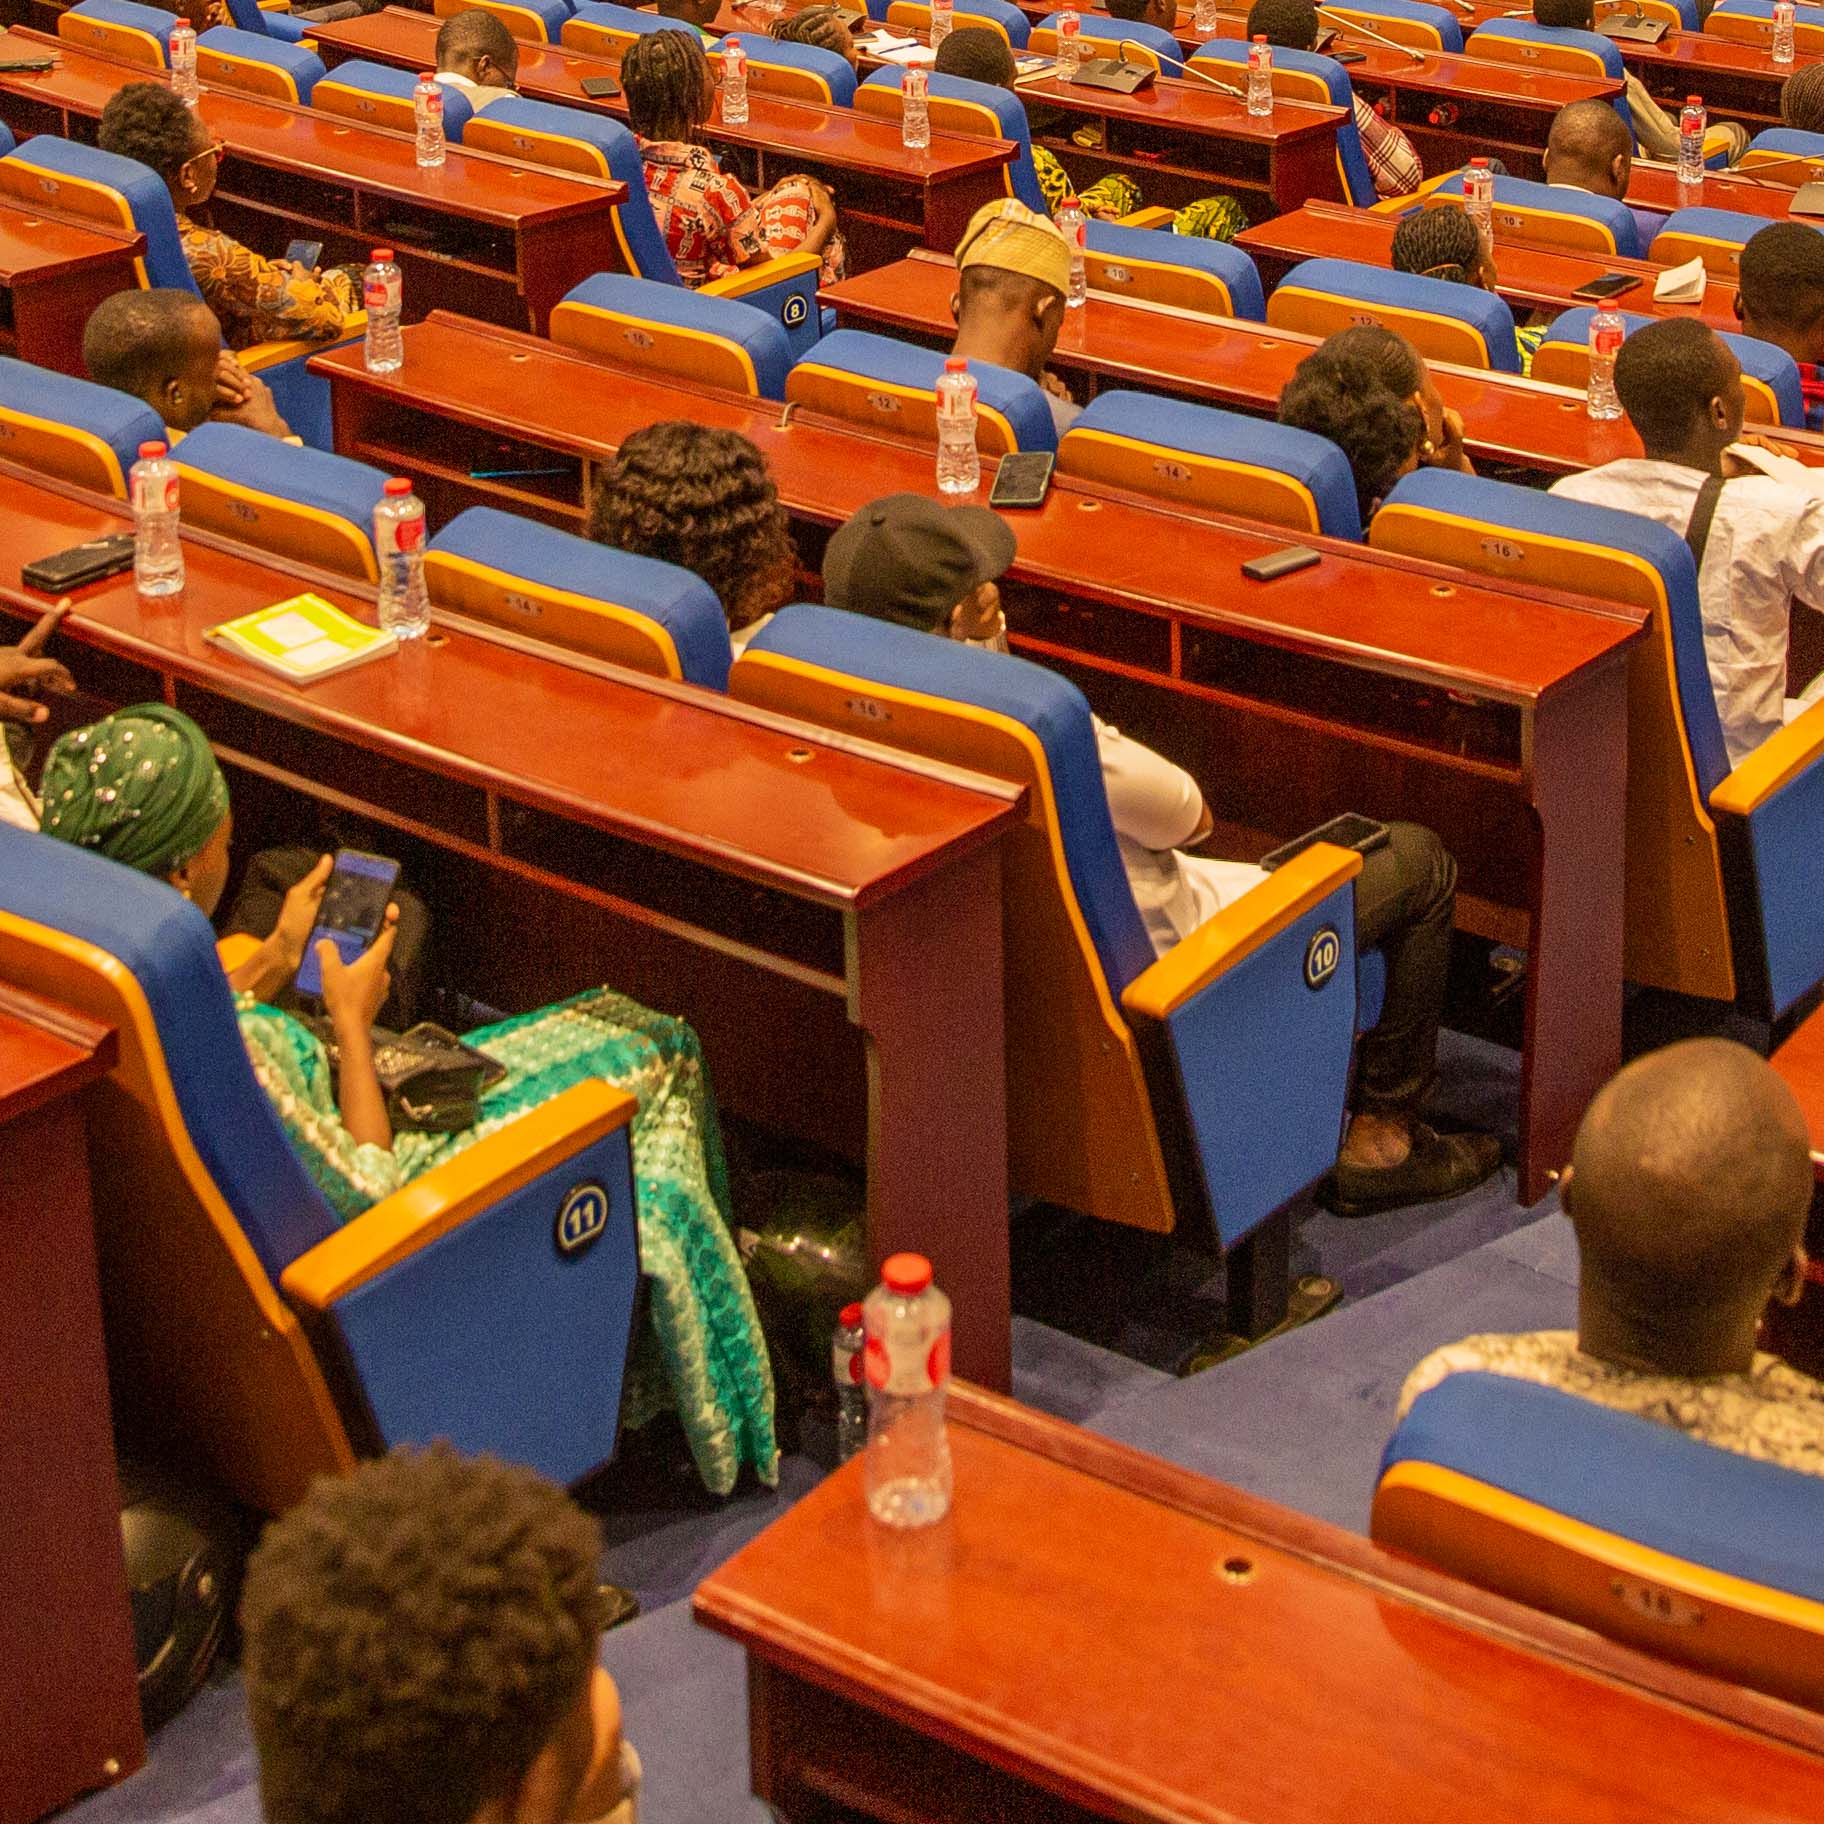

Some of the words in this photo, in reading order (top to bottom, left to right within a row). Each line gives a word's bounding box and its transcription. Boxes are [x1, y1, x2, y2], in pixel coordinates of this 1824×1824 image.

[1504, 217, 1515, 226] 10
[1112, 268, 1124, 279] 10
[790, 306, 801, 319] 8
[878, 397, 890, 409] 12
[1165, 467, 1179, 479] 14
[1495, 543, 1509, 557] 16
[1315, 942, 1332, 972] 10
[569, 1199, 595, 1235] 11
